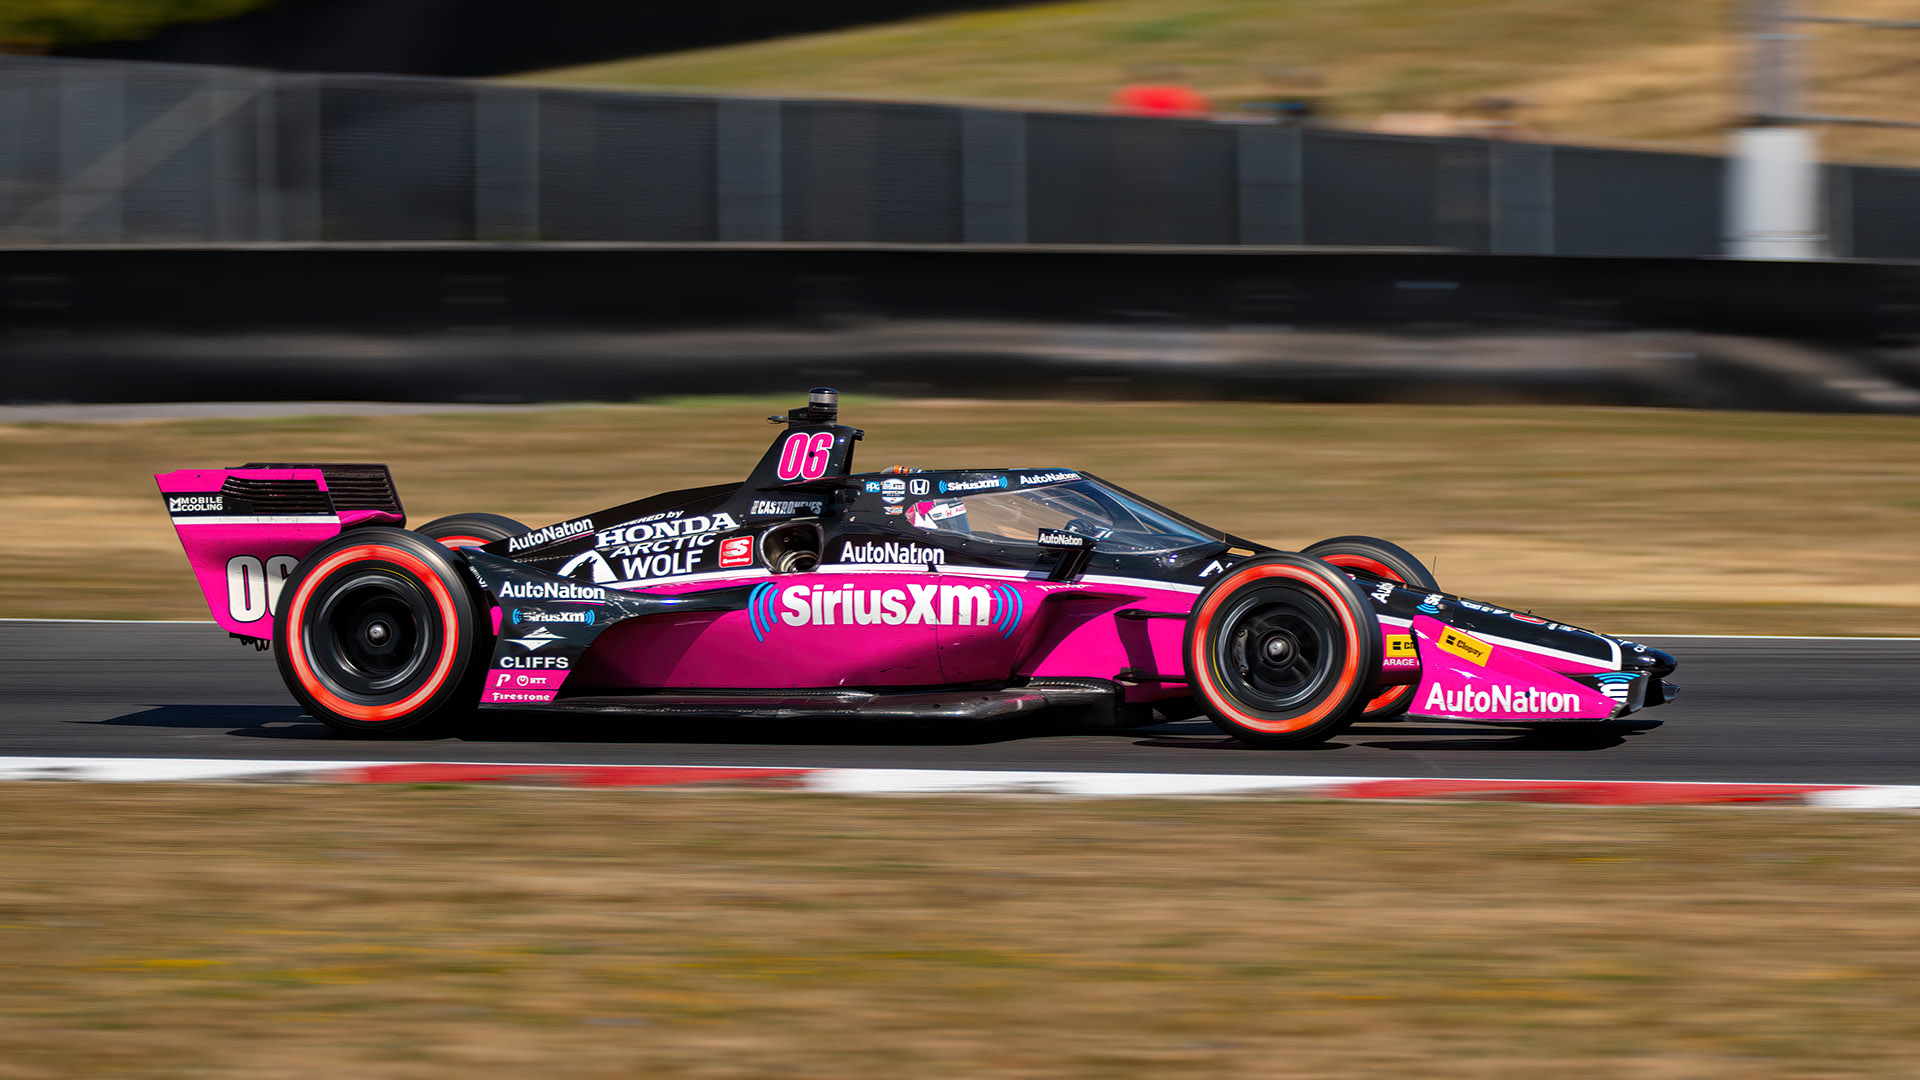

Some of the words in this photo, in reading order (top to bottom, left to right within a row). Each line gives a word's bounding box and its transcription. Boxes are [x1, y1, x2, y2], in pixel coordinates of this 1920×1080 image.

[777, 432, 834, 480] 06
[1020, 473, 1079, 485] AutoNation
[181, 496, 223, 504] MOBILE
[666, 510, 684, 519] by
[508, 517, 594, 553] AutoNation
[595, 512, 740, 548] HONDA
[610, 533, 717, 558] ARCTIC
[1039, 533, 1083, 546] AutoNation
[840, 541, 945, 565] AutoNation
[622, 549, 703, 580] WOLF
[500, 581, 605, 600] AutoNation
[1456, 640, 1484, 657] Clopay
[500, 656, 569, 669] CLIFFS
[1383, 658, 1414, 666] ARAGE
[492, 692, 550, 701] Firestone
[1425, 682, 1580, 713] AutoNation
